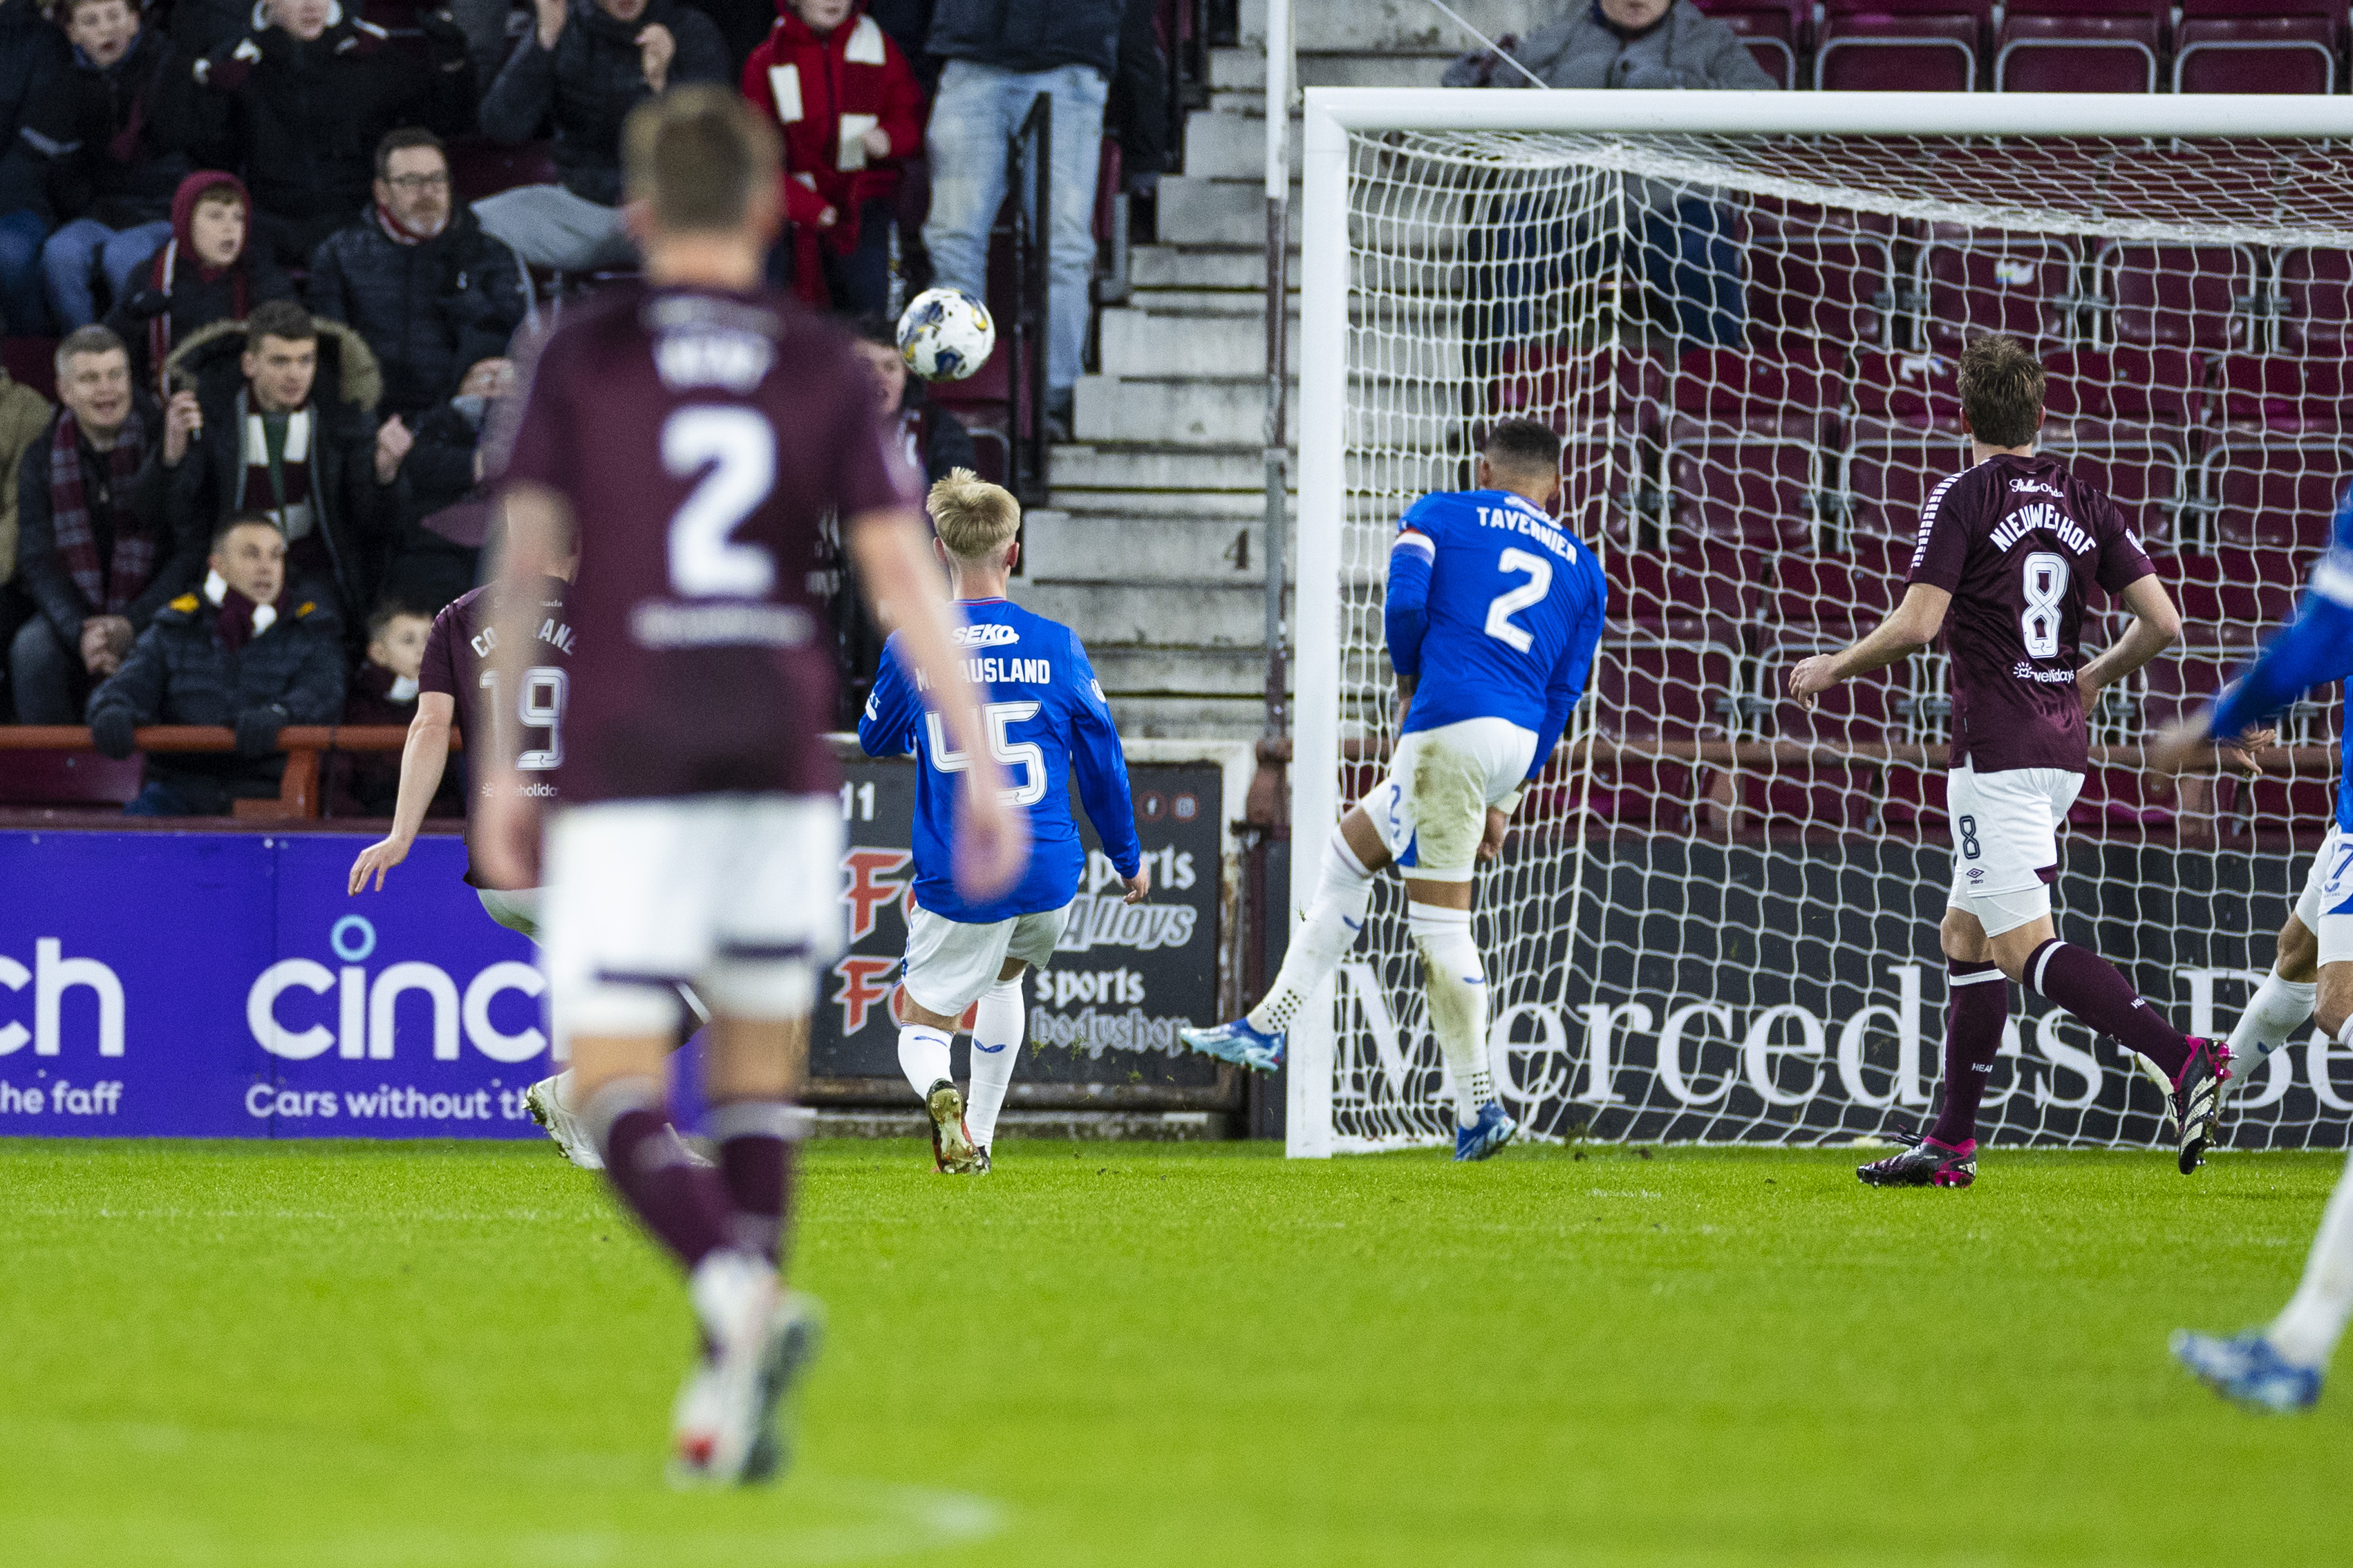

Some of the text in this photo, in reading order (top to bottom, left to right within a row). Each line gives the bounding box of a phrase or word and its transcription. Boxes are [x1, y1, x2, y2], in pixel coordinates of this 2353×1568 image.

[662, 405, 779, 600] 2
[1477, 507, 1577, 565] TAVERNIER
[1485, 547, 1553, 654] 2
[2023, 552, 2069, 659] 8
[471, 618, 576, 657] COANE
[953, 624, 1020, 650] SEKO
[915, 658, 1051, 692] MAUSLAND
[480, 666, 570, 770] 19
[925, 700, 1048, 810] 45
[1959, 815, 1981, 860] 8
[246, 914, 551, 1063] cinc
[1035, 966, 1145, 1008] sports
[51, 1079, 124, 1115] faff
[245, 1082, 339, 1118] Cars
[345, 1084, 491, 1120] without
